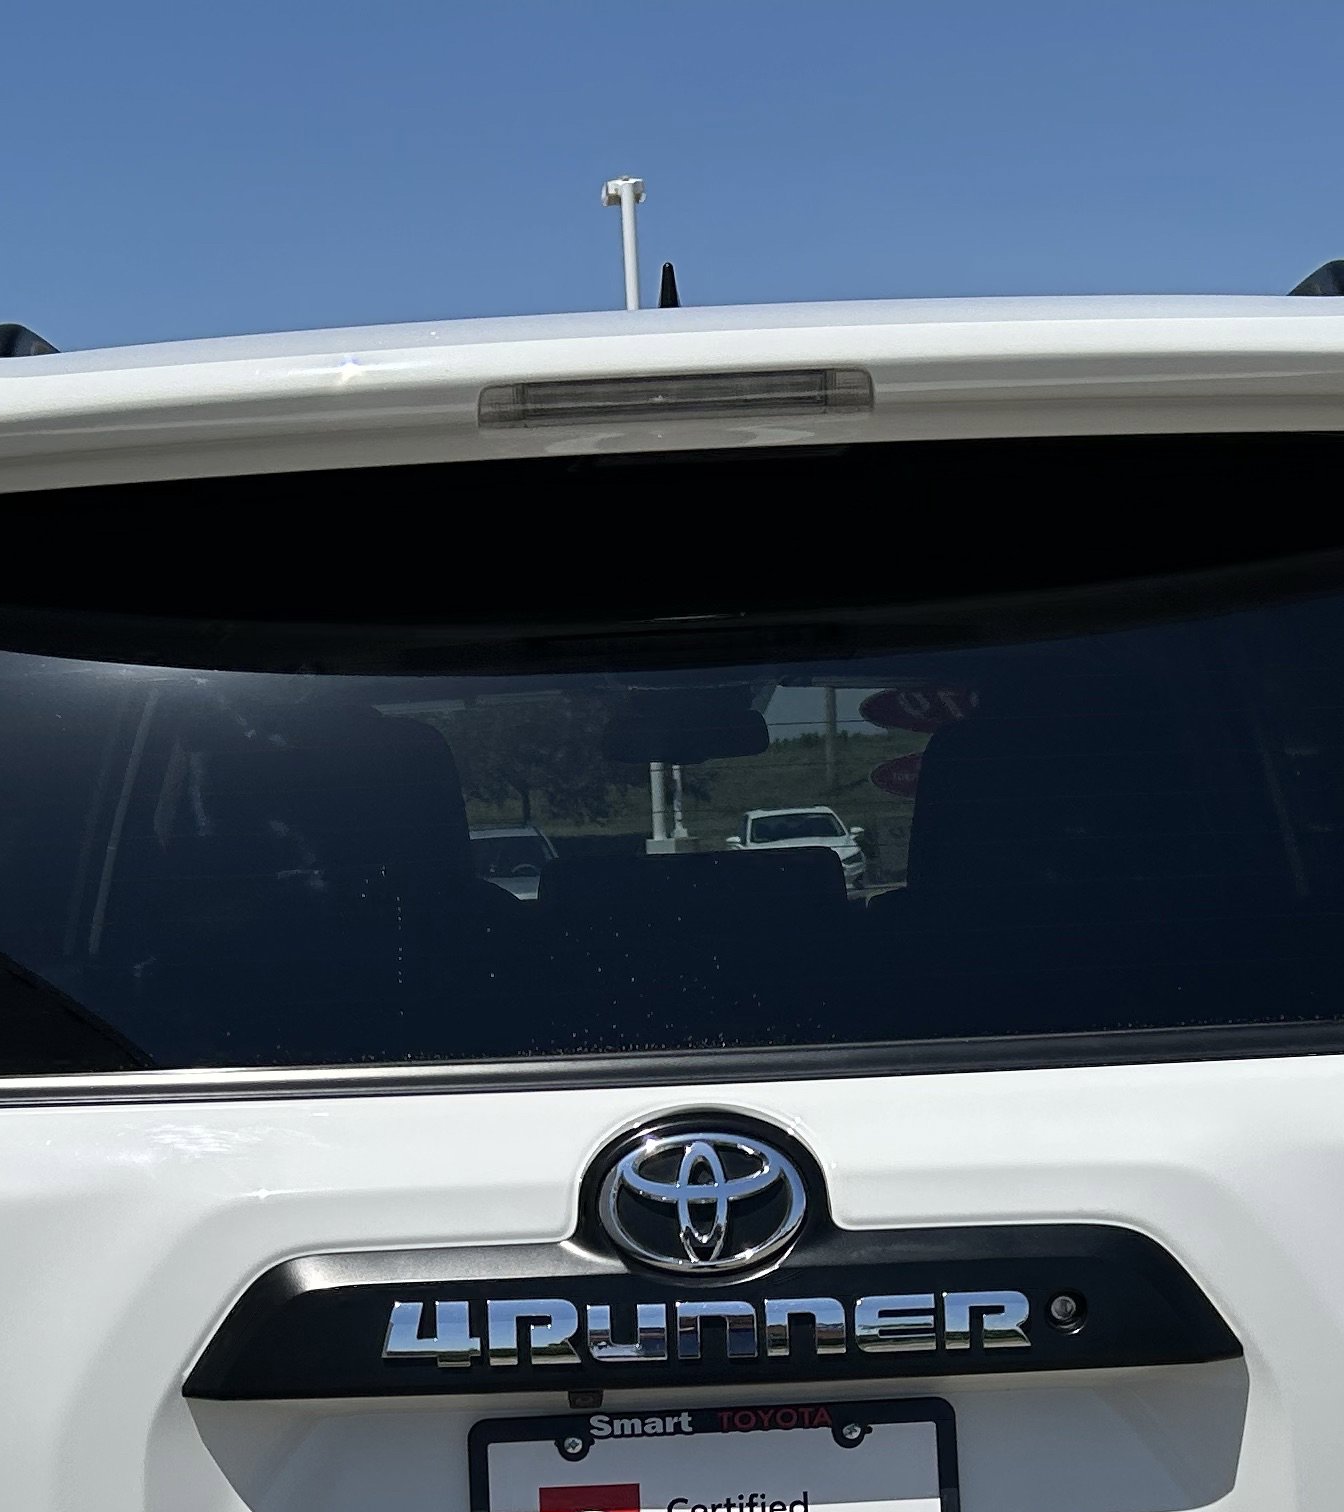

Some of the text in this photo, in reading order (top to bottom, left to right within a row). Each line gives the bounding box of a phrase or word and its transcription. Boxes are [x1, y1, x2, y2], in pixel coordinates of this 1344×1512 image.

[381, 1290, 1032, 1367] 4RUNNER
[588, 1407, 833, 1438] Smart TOYOTA
